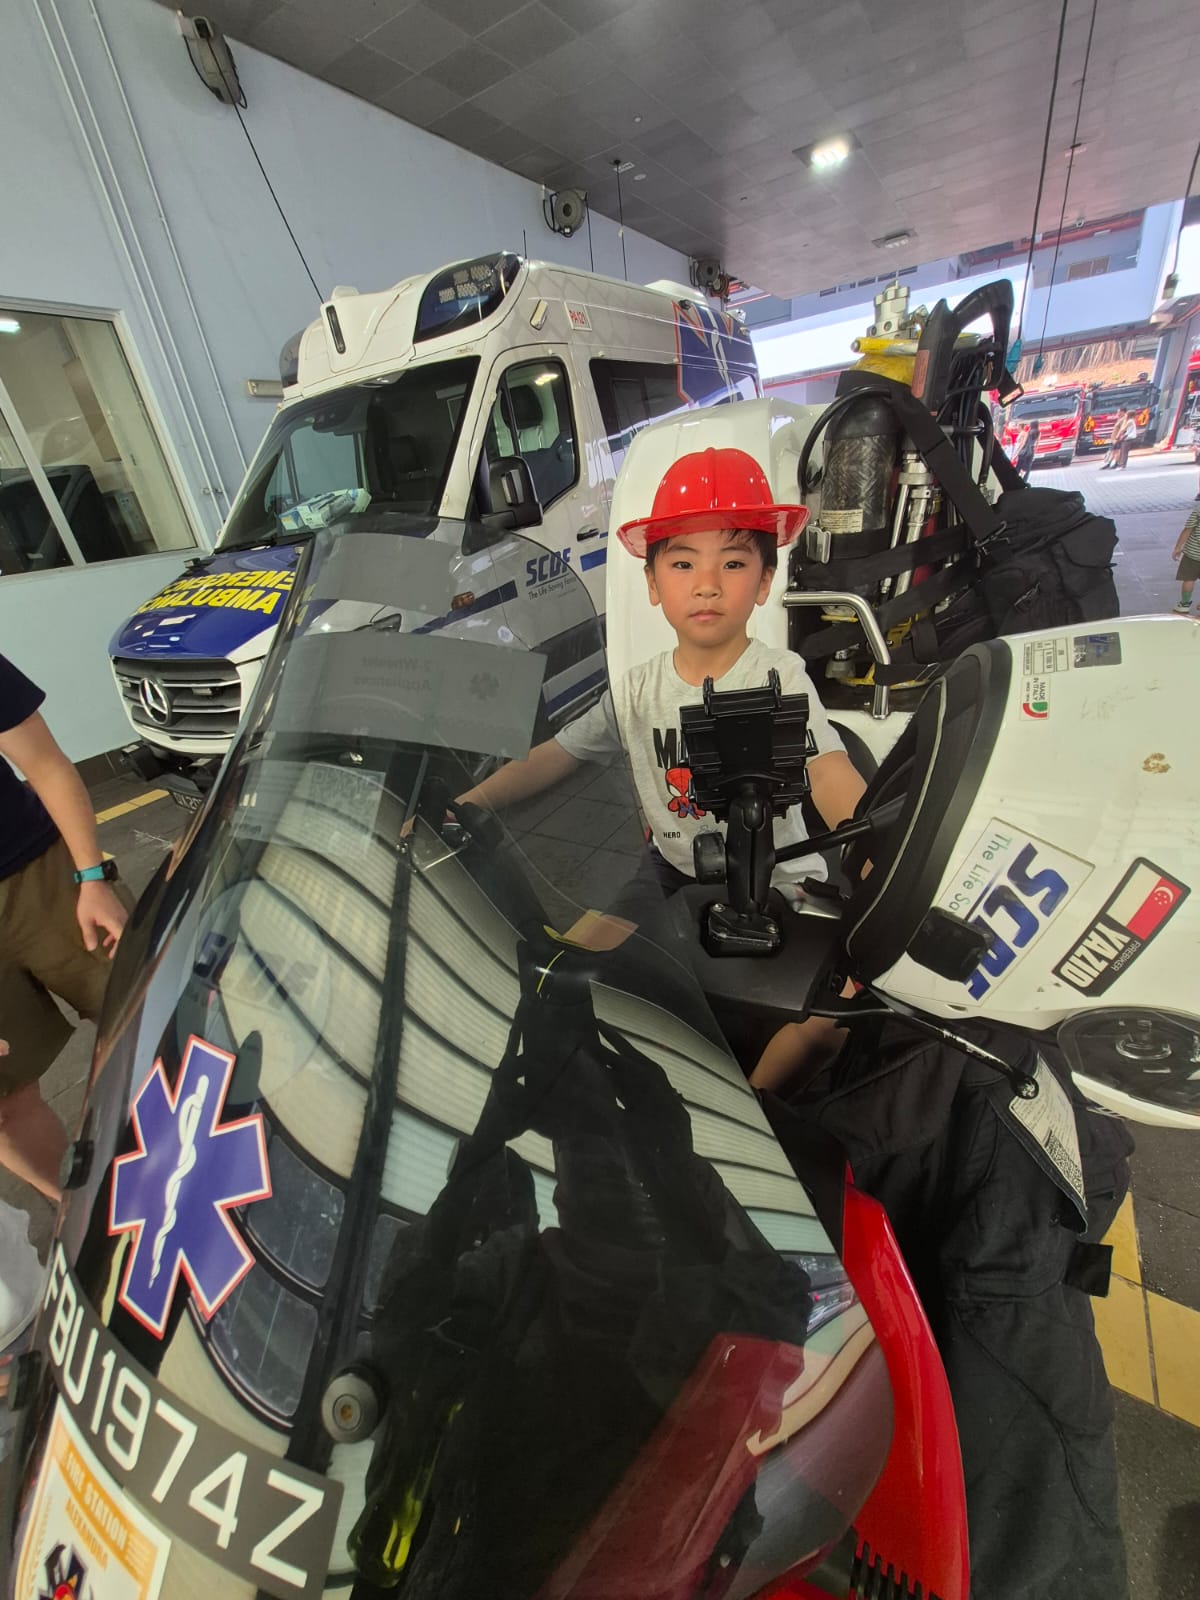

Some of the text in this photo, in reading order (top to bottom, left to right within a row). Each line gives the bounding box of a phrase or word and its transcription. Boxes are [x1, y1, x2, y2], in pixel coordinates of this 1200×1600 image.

[528, 590, 538, 600] The
[663, 831, 681, 839] HERO
[948, 833, 1012, 911] The Life Sa
[1059, 922, 1132, 988] YAZID
[44, 1242, 325, 1589] FBU1974Z
[66, 1451, 128, 1551] FIRE STATION
